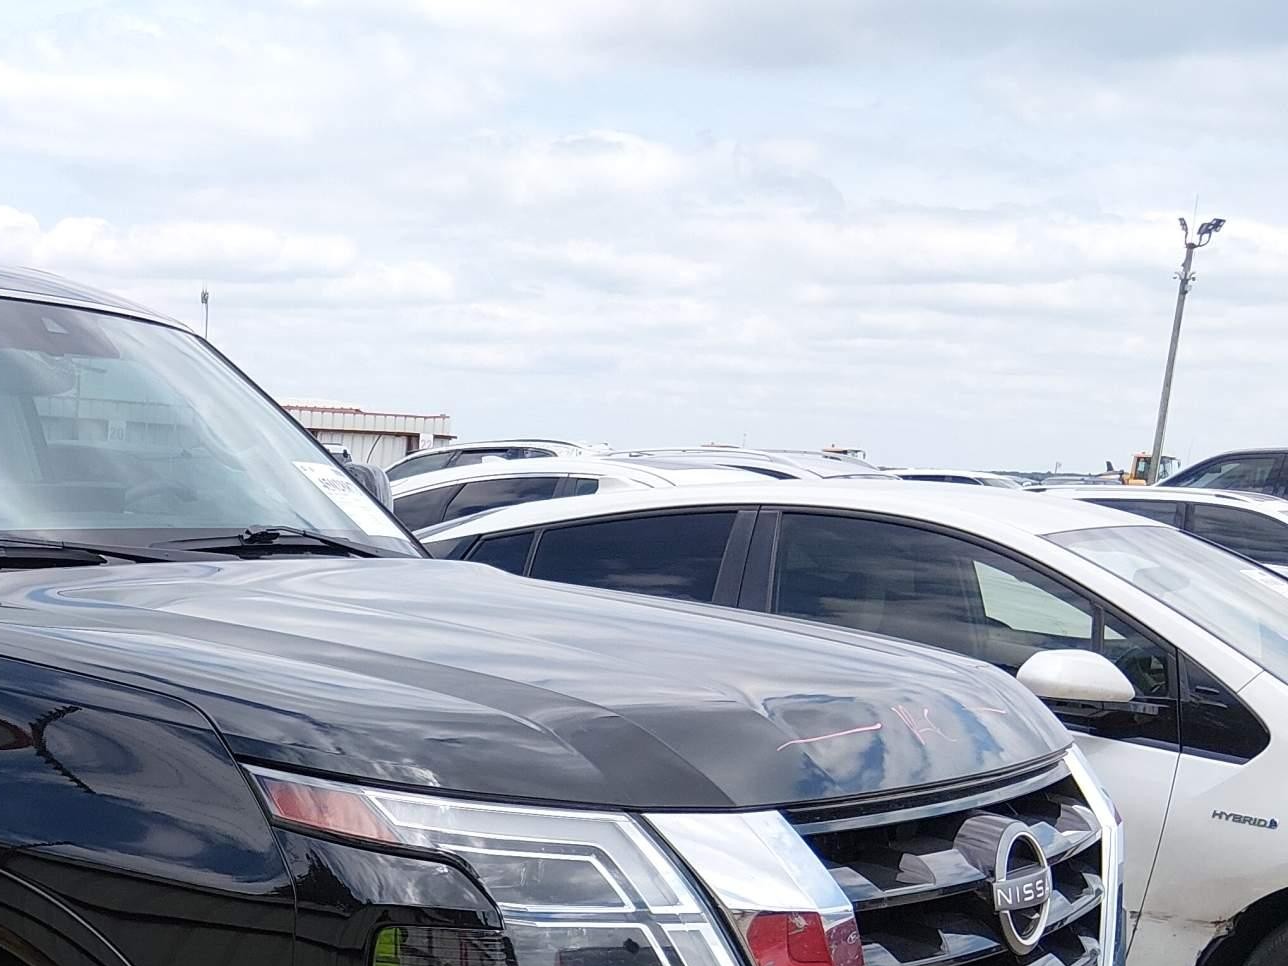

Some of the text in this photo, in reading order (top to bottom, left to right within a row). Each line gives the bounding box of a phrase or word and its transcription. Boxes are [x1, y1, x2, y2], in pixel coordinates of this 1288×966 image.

[420, 438, 432, 449] 22
[1211, 809, 1268, 828] HYBRID
[996, 878, 1050, 906] NISS
